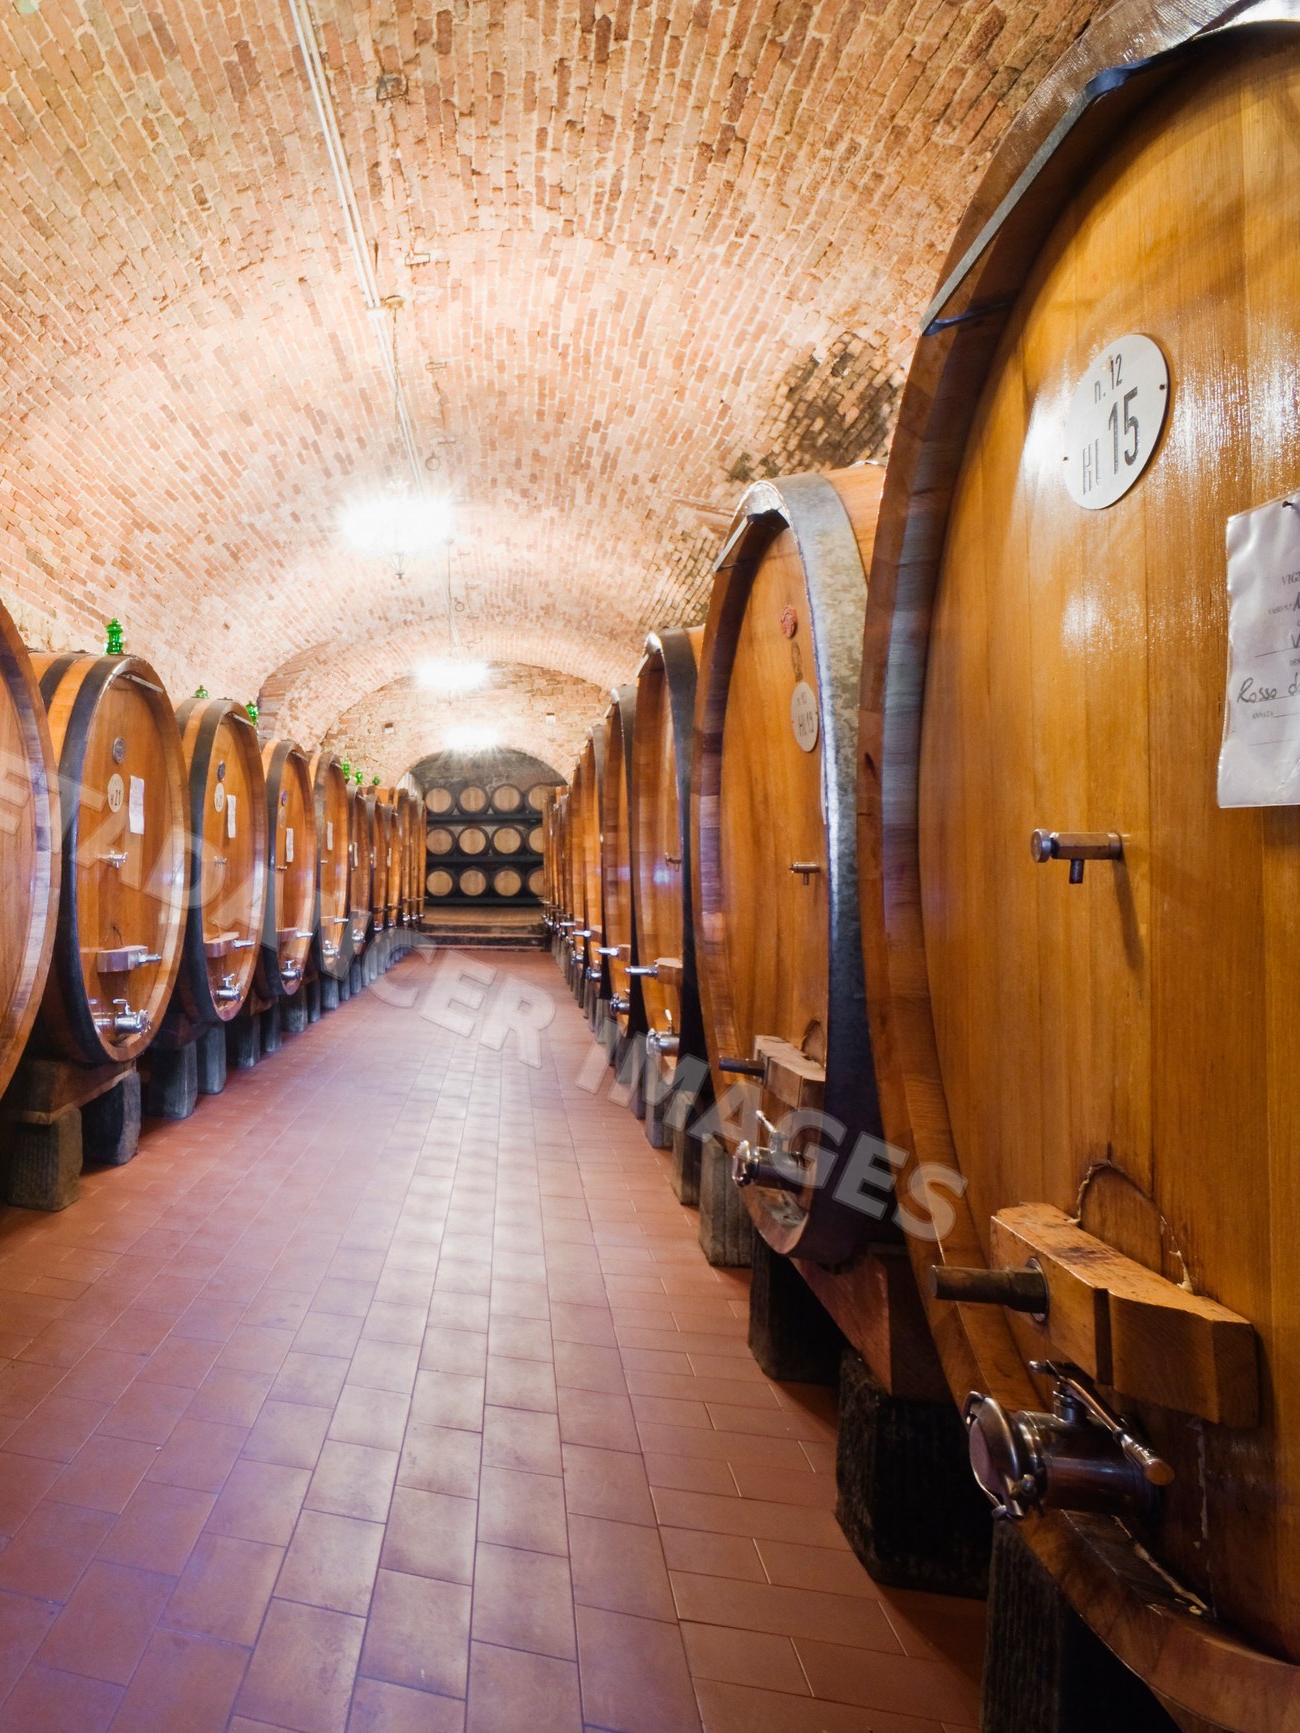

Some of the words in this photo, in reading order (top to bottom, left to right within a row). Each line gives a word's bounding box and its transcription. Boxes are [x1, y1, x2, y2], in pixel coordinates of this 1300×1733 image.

[1109, 353, 1123, 390] 12
[1108, 386, 1139, 475] 15
[1237, 676, 1277, 703] Rosso
